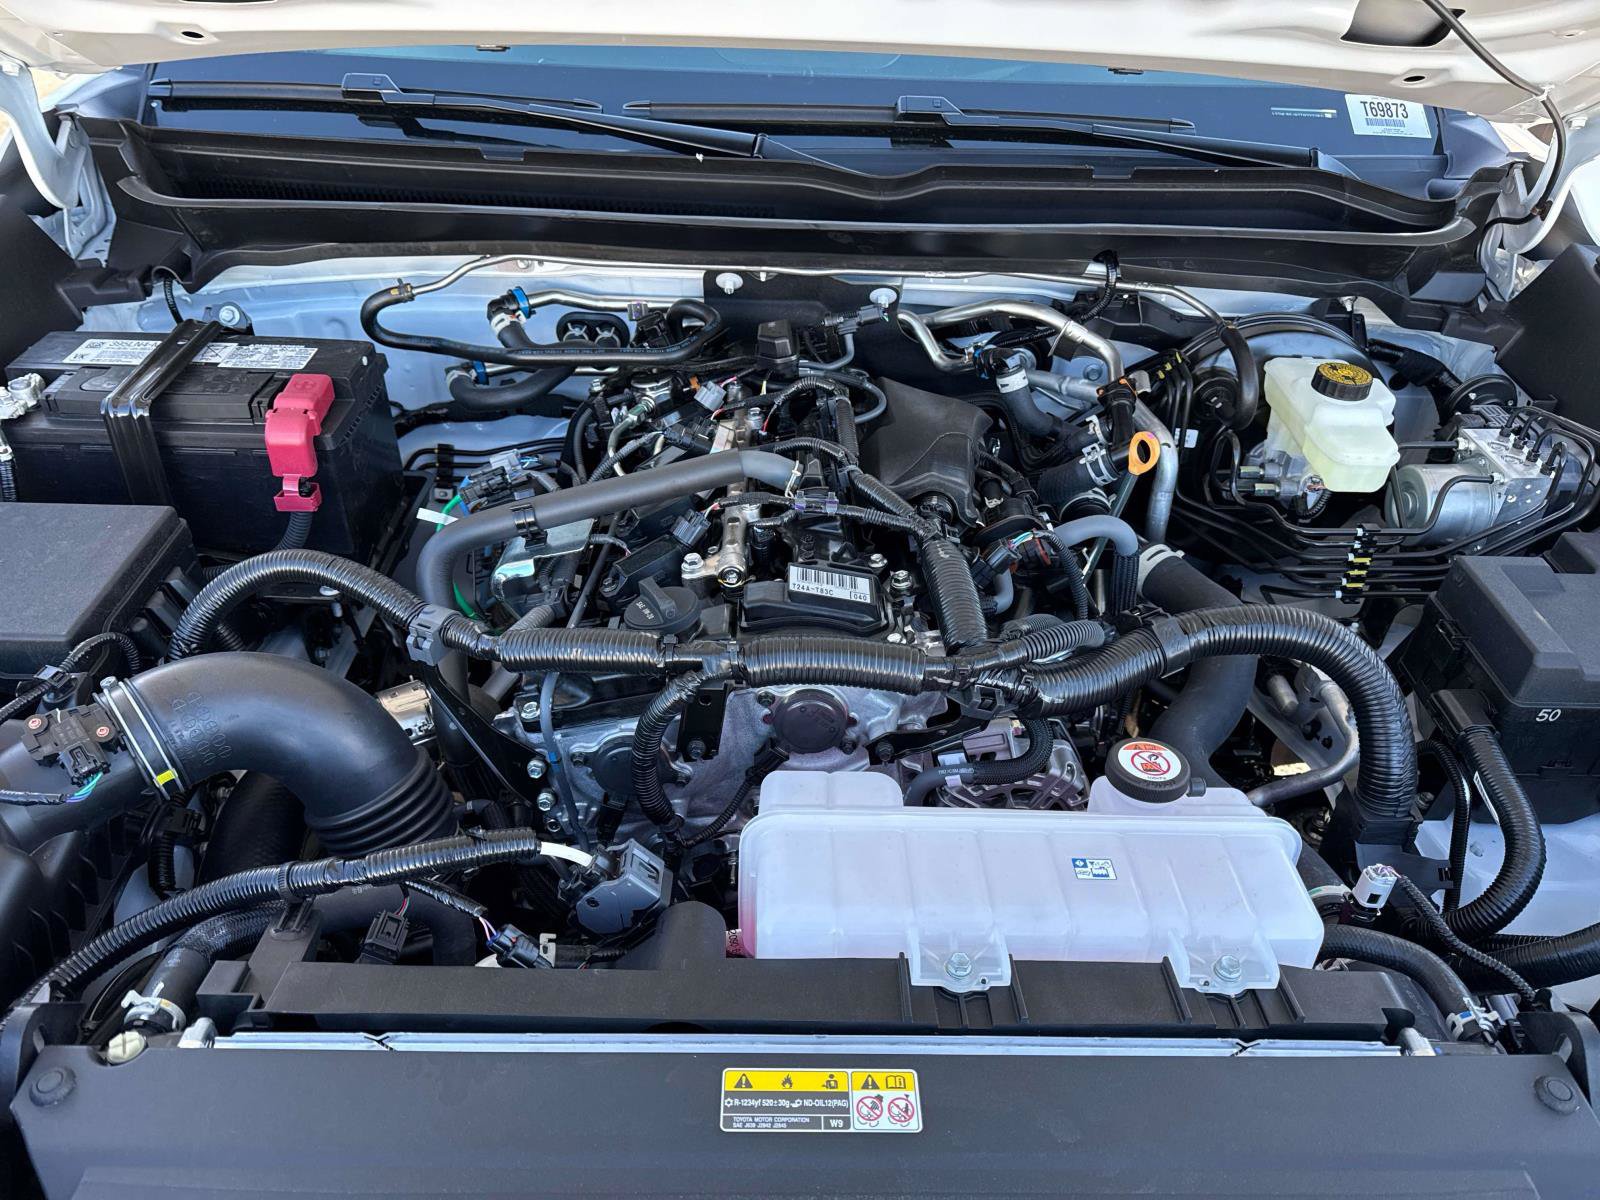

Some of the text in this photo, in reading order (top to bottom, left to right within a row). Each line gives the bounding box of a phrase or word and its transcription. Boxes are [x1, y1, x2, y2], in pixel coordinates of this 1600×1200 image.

[1360, 101, 1409, 119] T69873
[1535, 708, 1562, 722] 50
[733, 1098, 762, 1108] R-1234yf
[803, 1099, 849, 1109] ND-OIL12(PAG)
[830, 1119, 844, 1128] W9
